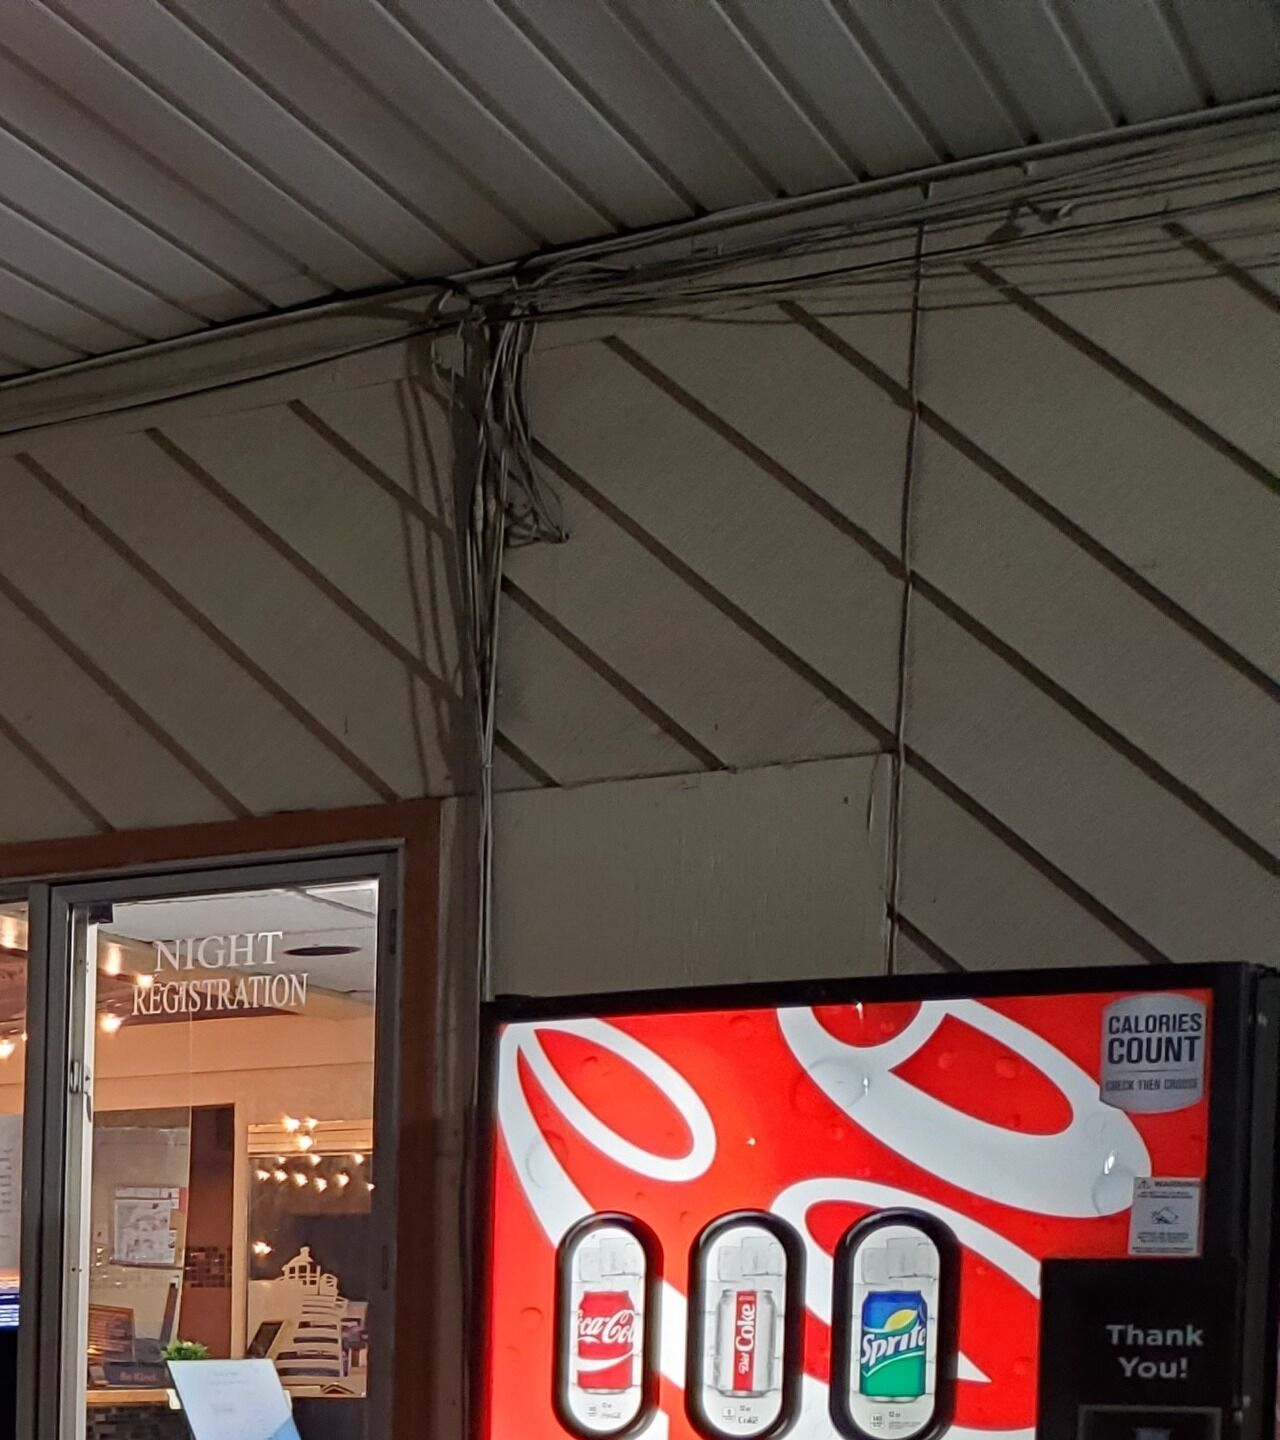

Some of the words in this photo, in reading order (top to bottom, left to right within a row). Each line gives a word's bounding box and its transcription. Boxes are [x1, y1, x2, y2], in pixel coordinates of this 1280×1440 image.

[153, 931, 283, 972] NIGHT
[131, 973, 310, 1016] REGISTRATION
[1108, 1013, 1202, 1034] CALORIES
[1108, 1036, 1201, 1064] COUNT
[735, 1304, 755, 1352] Coke
[861, 1320, 926, 1366] Sprite
[1105, 1324, 1203, 1346] Thank
[1117, 1357, 1188, 1378] You!
